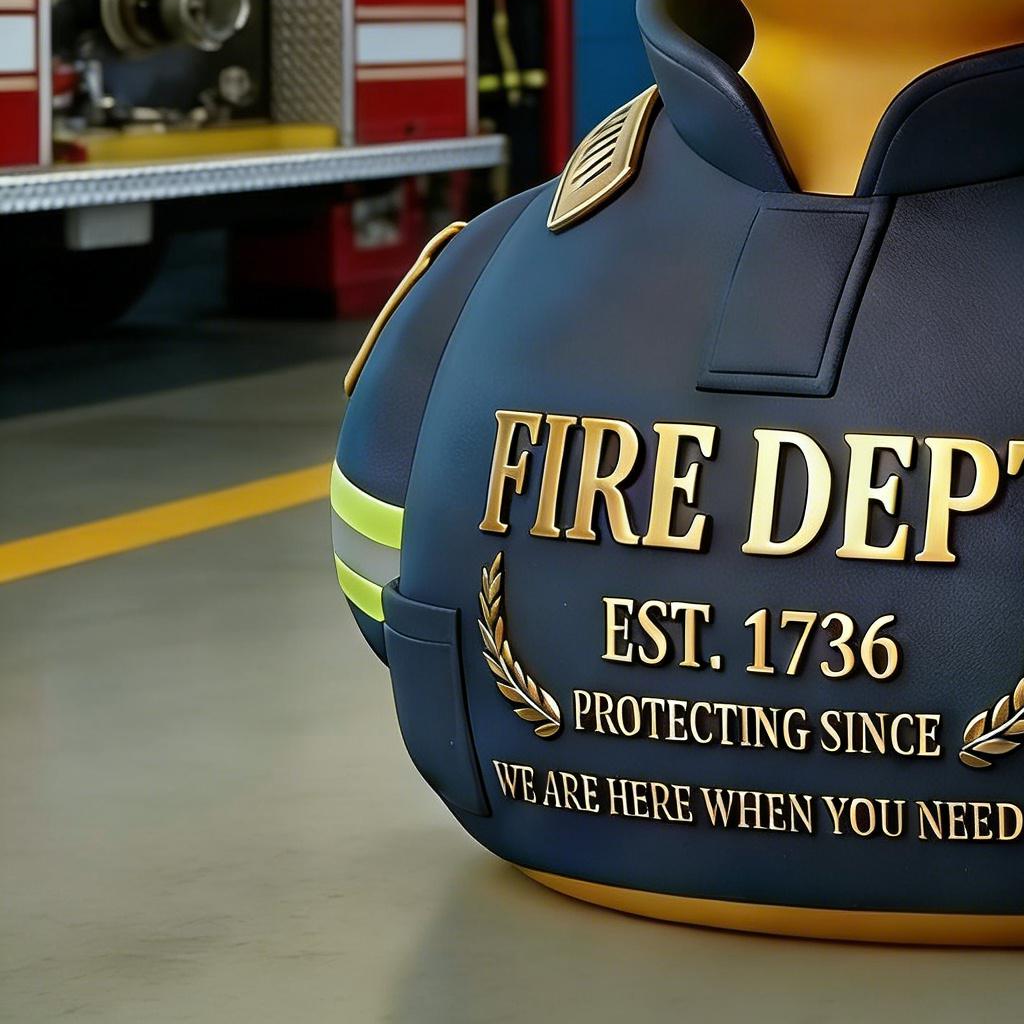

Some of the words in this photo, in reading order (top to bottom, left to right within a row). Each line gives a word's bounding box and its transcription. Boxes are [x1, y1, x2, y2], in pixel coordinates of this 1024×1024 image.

[479, 410, 717, 550] FIRE
[601, 596, 722, 670] EST.
[744, 607, 900, 679] 1736
[573, 689, 809, 751] PROTECTING
[820, 711, 942, 757] SINCE
[493, 760, 535, 801] WE
[542, 771, 600, 814] ARE
[606, 778, 694, 822] HERE
[701, 788, 813, 834] WHEN
[822, 795, 906, 838] YOU
[917, 801, 1024, 841] NEED
